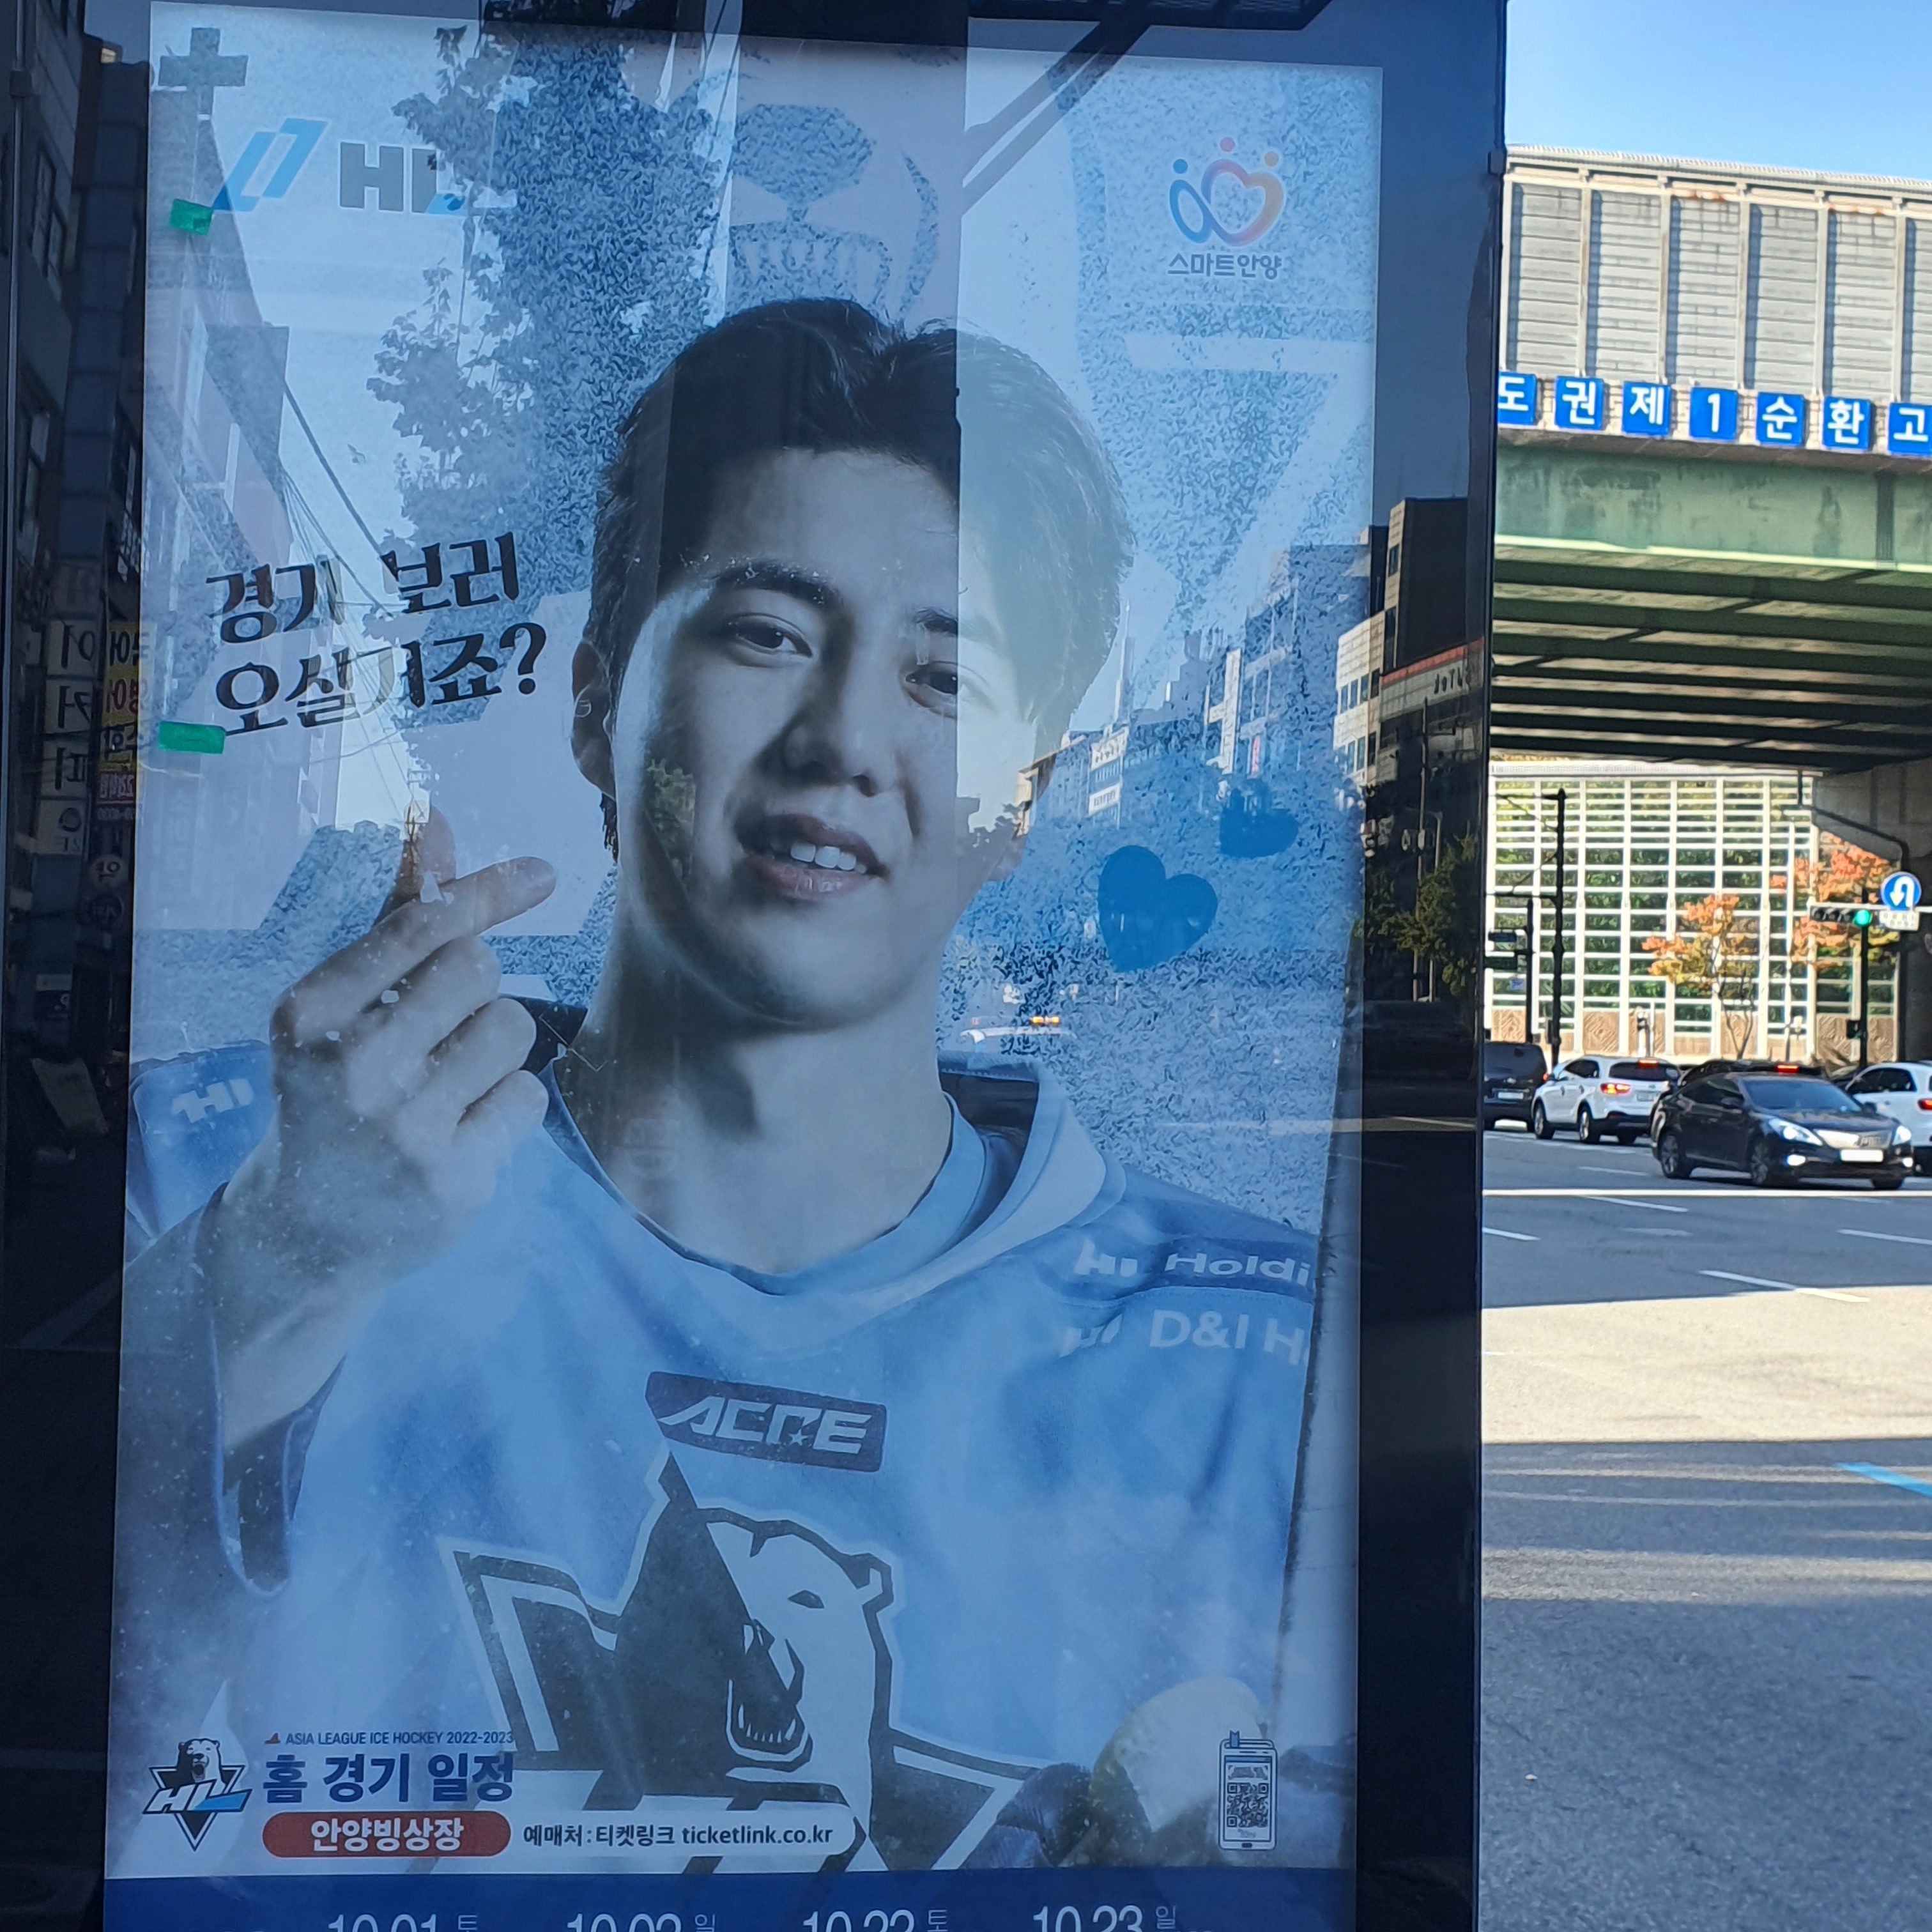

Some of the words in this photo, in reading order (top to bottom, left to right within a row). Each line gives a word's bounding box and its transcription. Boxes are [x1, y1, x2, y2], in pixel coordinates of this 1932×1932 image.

[1167, 252, 1282, 280] 스마트안양
[206, 555, 344, 643] 경기
[379, 531, 519, 614] 보러
[1165, 1252, 1314, 1287] Holdi
[1263, 1317, 1310, 1366] H
[286, 1733, 314, 1745] ASIA
[318, 1732, 367, 1745] LEAGUE
[369, 1732, 390, 1745] ICE
[393, 1731, 443, 1745] HOCKEY
[447, 1731, 513, 1744] 2022-2023
[263, 1754, 308, 1804] 홈
[323, 1753, 410, 1803] 경기
[428, 1752, 513, 1802] 일정
[310, 1817, 464, 1852] 안양빙상장
[682, 1824, 834, 1844] ticketlink.co.kr
[926, 1908, 949, 1932] 토
[1155, 1905, 1176, 1930] 일
